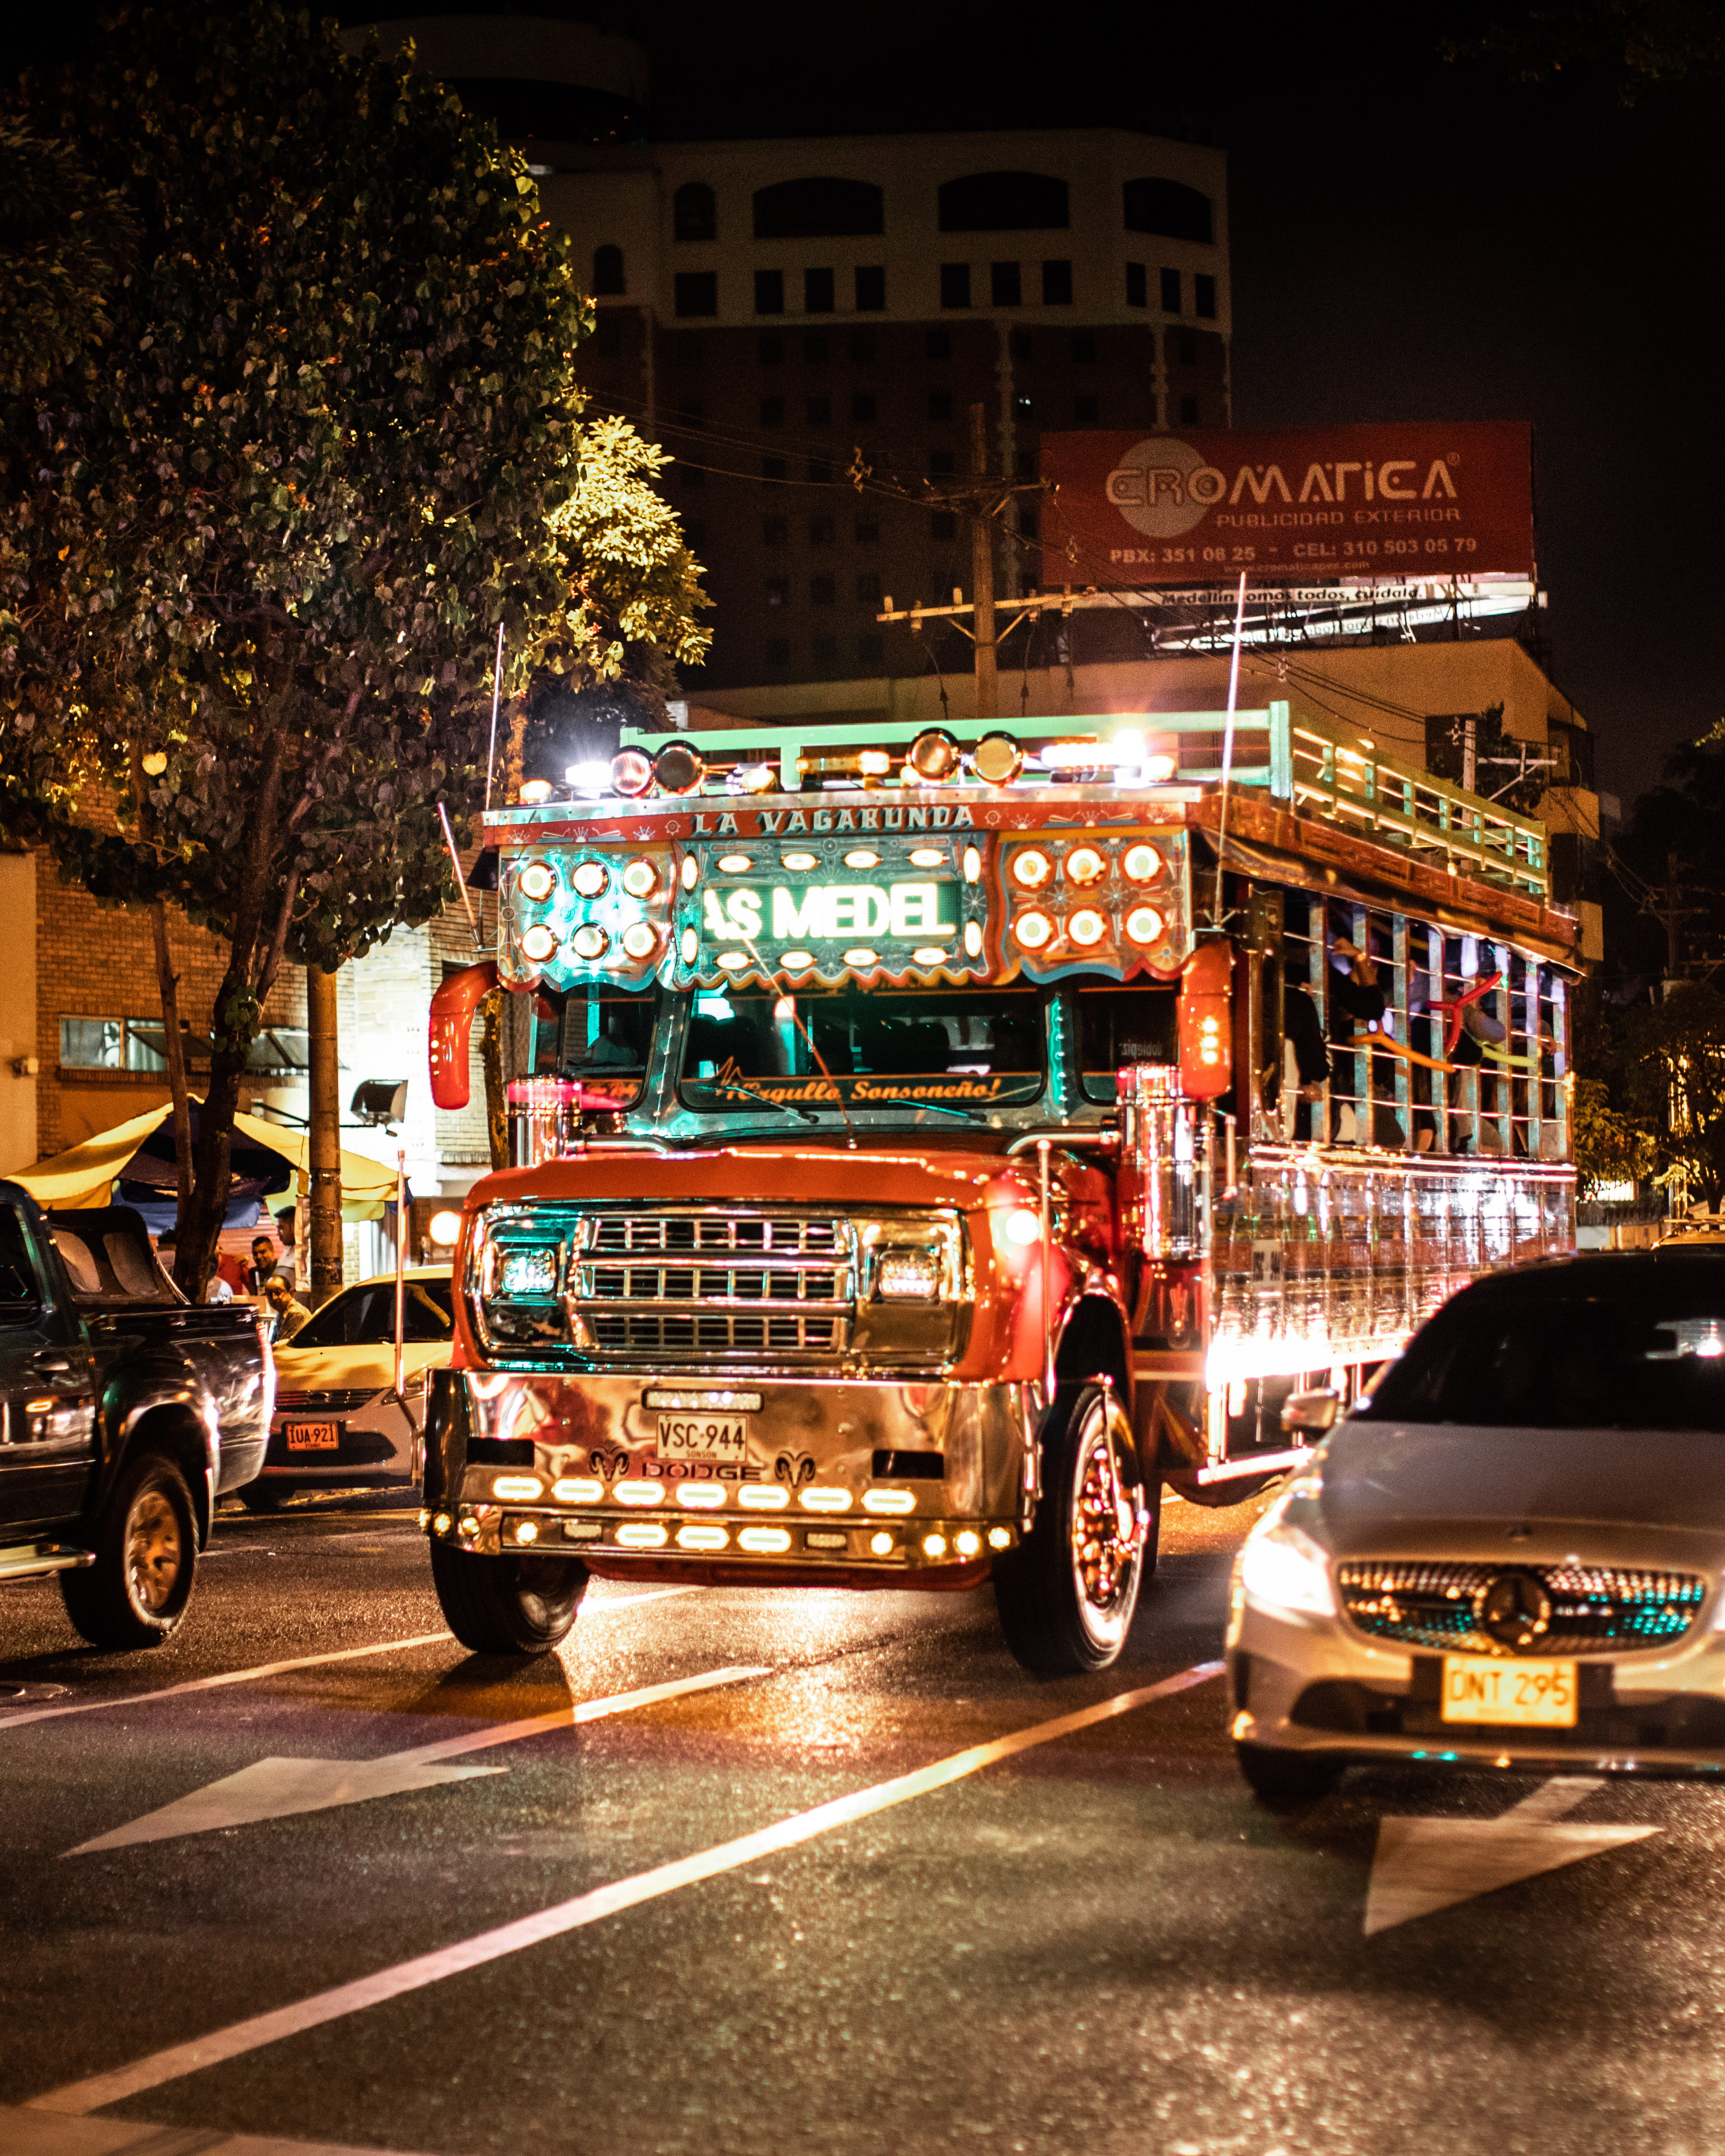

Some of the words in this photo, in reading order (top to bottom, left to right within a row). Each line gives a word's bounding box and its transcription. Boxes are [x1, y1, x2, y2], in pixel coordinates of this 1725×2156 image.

[1216, 511, 1344, 528] PUBLICIDAD
[1354, 507, 1461, 525] EXTERIOR
[1110, 549, 1156, 564] PBX:
[1162, 548, 1196, 563] 351
[1203, 547, 1226, 562] 08
[1232, 546, 1256, 561] 25
[1293, 542, 1336, 557] CEL:
[1343, 541, 1378, 555] 310
[1384, 539, 1418, 553] 503
[1455, 537, 1477, 552] 79
[691, 812, 739, 837] LA
[772, 883, 956, 938] MEDEL
[642, 1463, 761, 1481] DODGE
